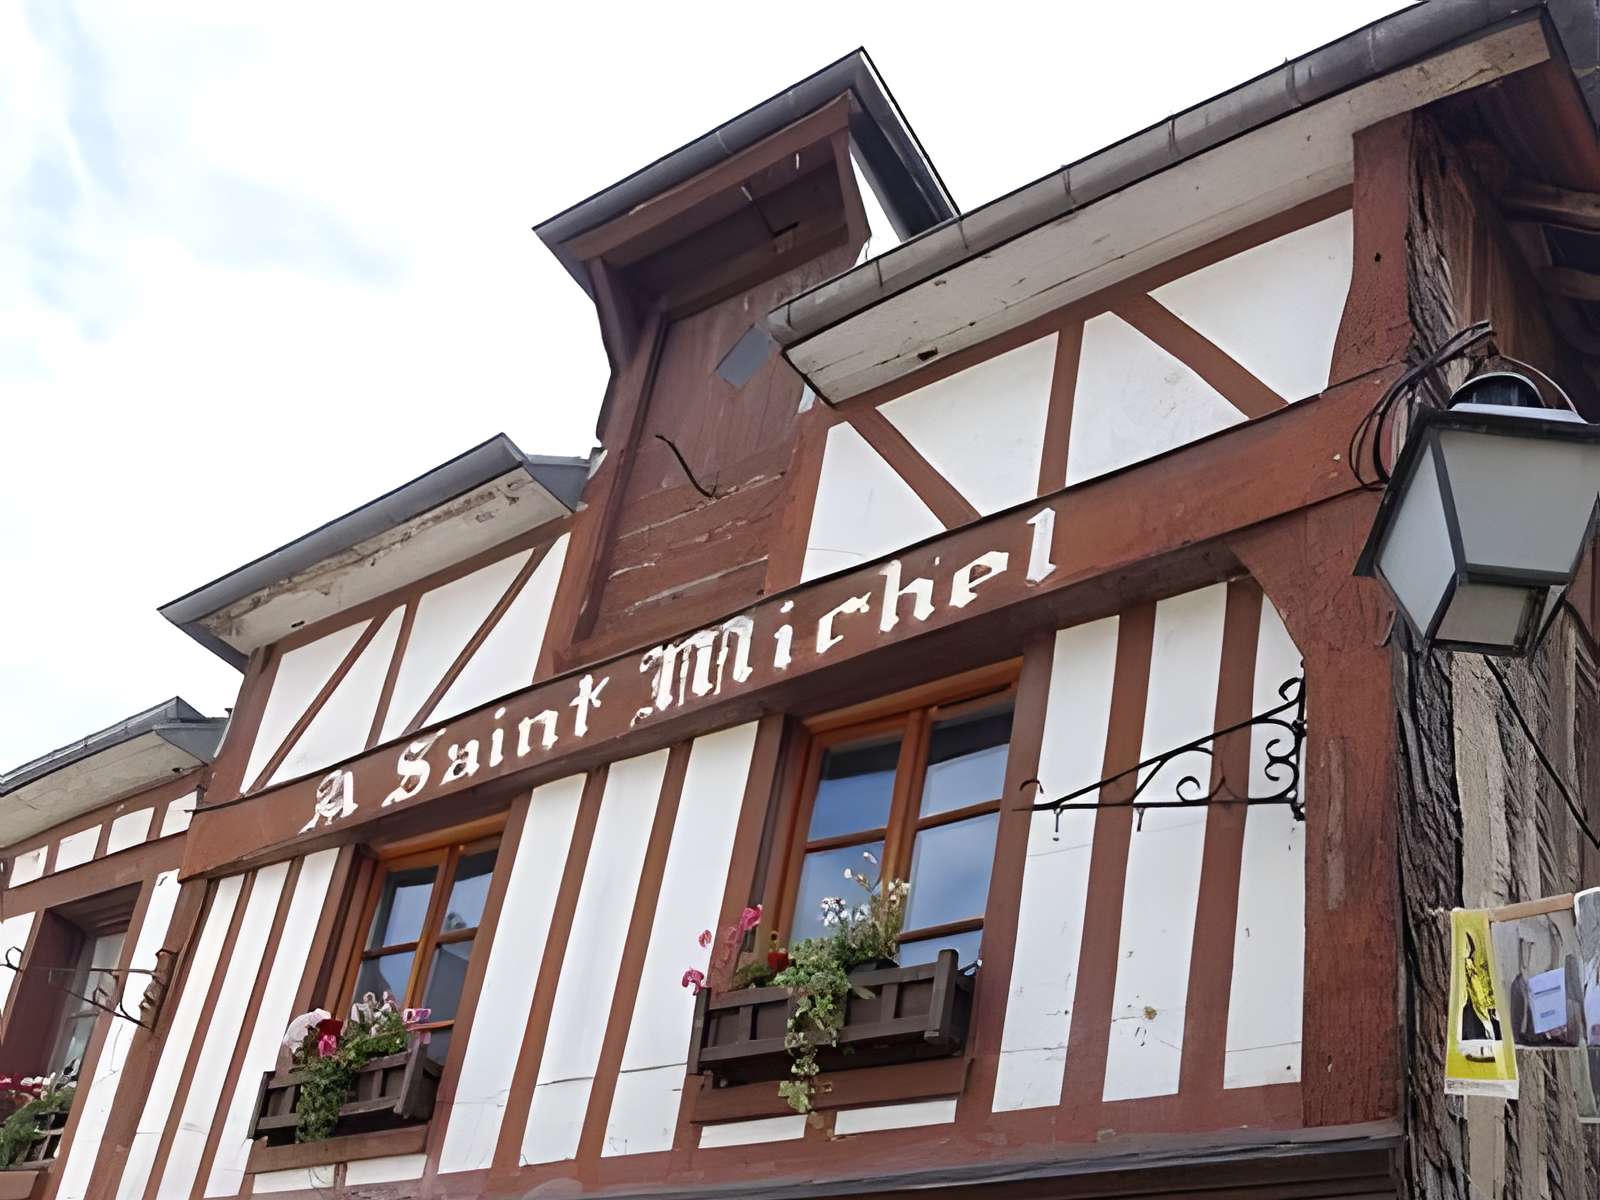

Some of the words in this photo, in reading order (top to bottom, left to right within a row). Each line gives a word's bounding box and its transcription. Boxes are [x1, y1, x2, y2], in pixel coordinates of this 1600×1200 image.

[298, 769, 359, 834] A
[381, 673, 610, 808] Saint
[630, 506, 1058, 728] Michel
